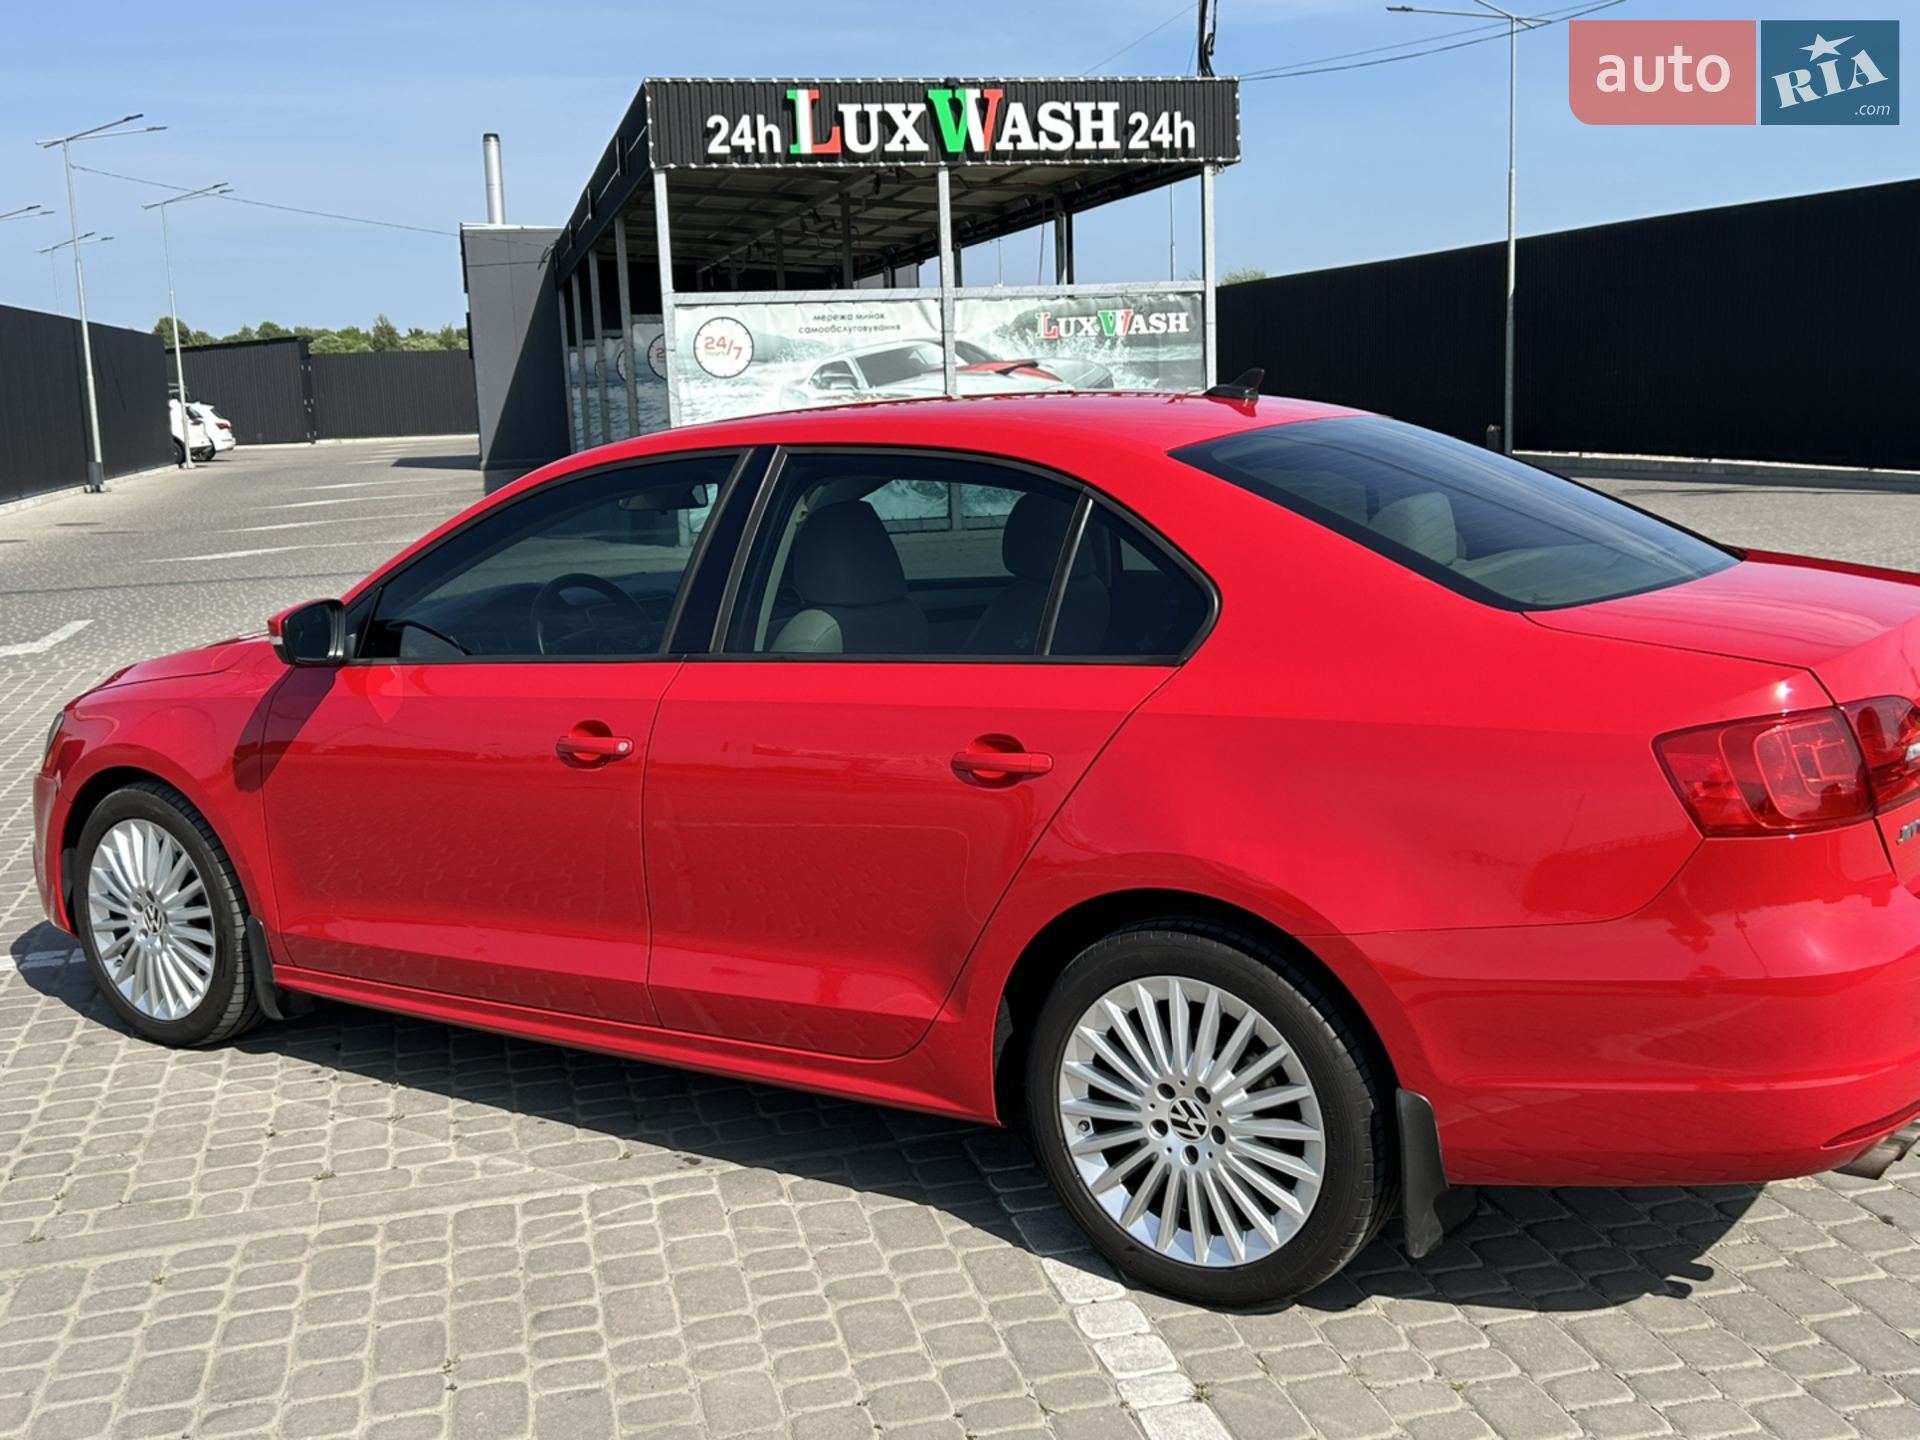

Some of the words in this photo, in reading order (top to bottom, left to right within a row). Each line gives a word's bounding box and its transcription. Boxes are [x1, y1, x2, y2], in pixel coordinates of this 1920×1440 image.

[706, 114, 782, 154] 24h
[1128, 111, 1196, 150] 24h
[704, 336, 743, 360] 24/7
